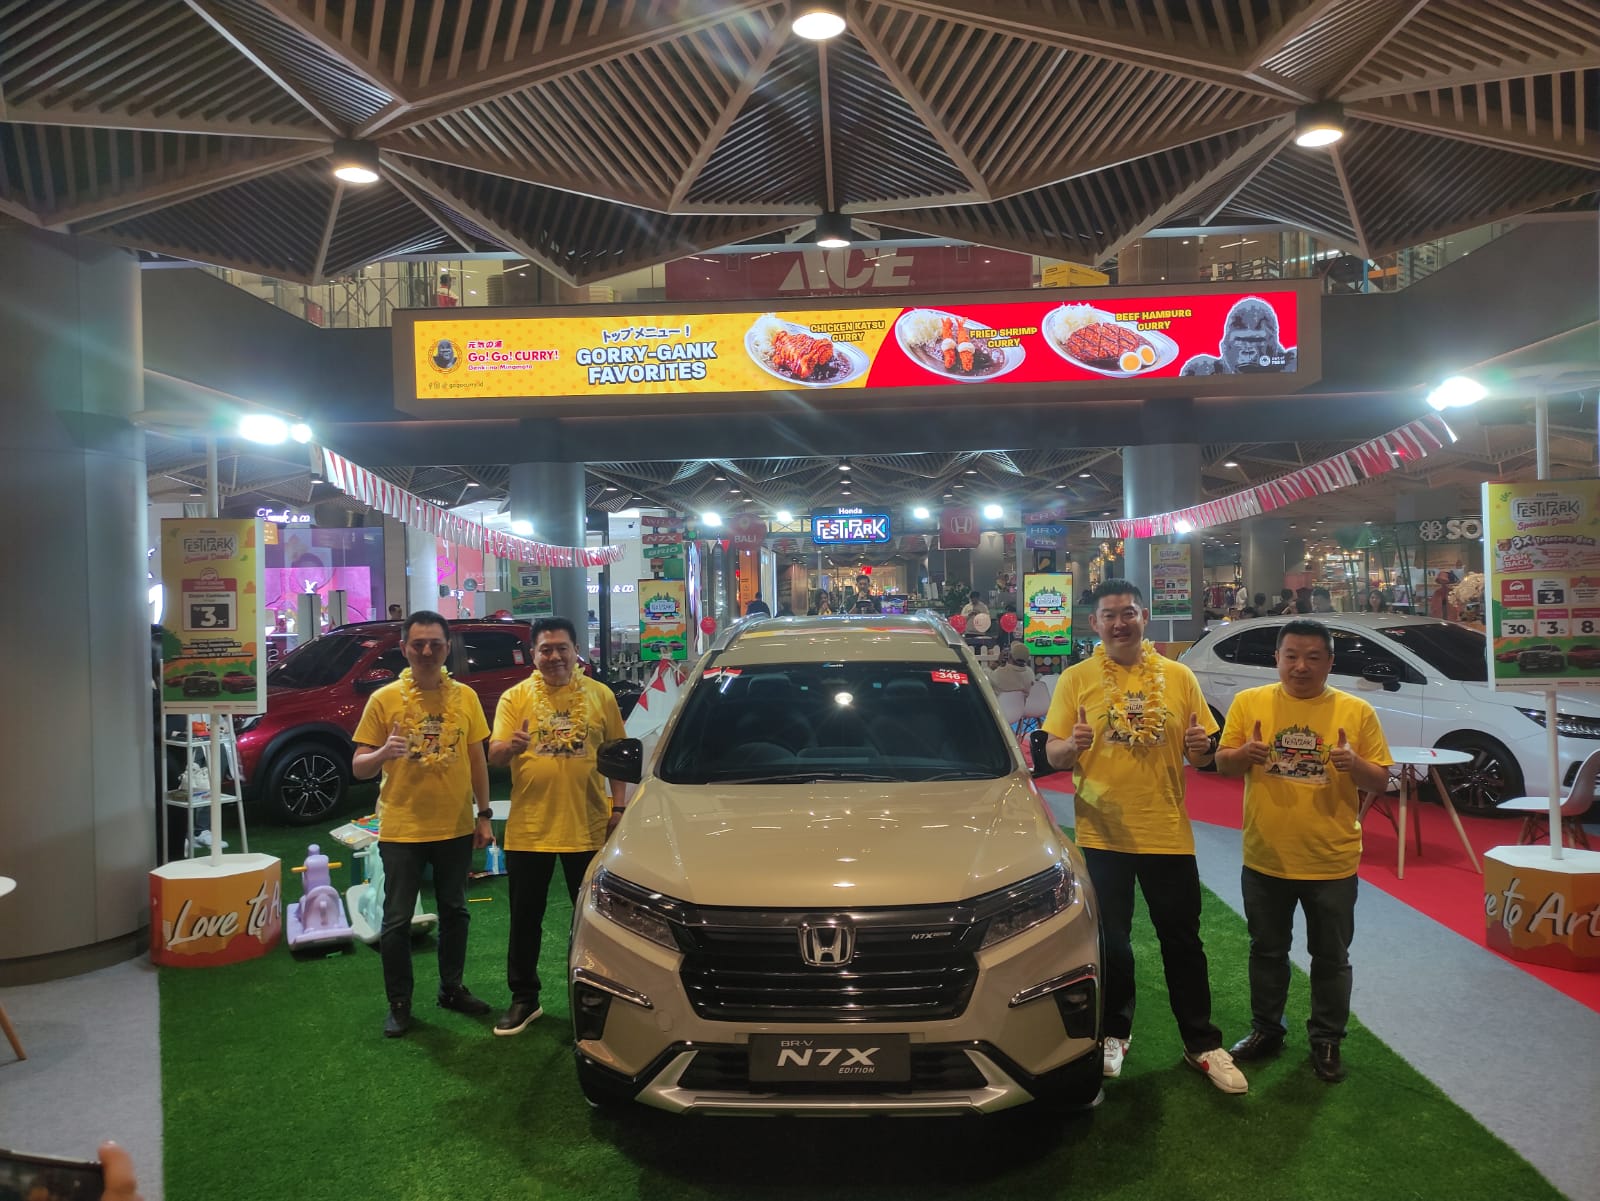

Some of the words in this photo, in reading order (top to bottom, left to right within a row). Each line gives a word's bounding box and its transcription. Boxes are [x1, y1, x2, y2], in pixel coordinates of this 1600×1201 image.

[778, 246, 914, 290] ACE
[1116, 312, 1140, 322] BEEF
[1142, 309, 1192, 320] HAMBURG
[810, 322, 853, 334] CHICKEN
[854, 320, 885, 331] KATSU
[1137, 320, 1171, 331] CURRY
[831, 332, 865, 342] CURRY
[970, 329, 997, 339] FRIED
[999, 327, 1038, 337] SHRIMP
[988, 338, 1021, 348] CURRY
[468, 352, 489, 362] Go!
[491, 351, 513, 361] Go!
[515, 350, 558, 361] CURRY!
[576, 342, 718, 366] GORRY-GANK
[588, 361, 707, 385] FAVORITES
[817, 518, 886, 539] FESTIPARK
[734, 535, 757, 543] BALI
[648, 547, 679, 556] BRIO
[1544, 591, 1556, 603] 3
[200, 606, 217, 627] 3
[1508, 624, 1526, 635] 30
[1547, 621, 1559, 635] 3
[1581, 620, 1594, 634] 8
[1503, 878, 1525, 930] to
[166, 898, 239, 947] Love
[247, 880, 270, 936] to
[776, 1048, 880, 1067] N7X
